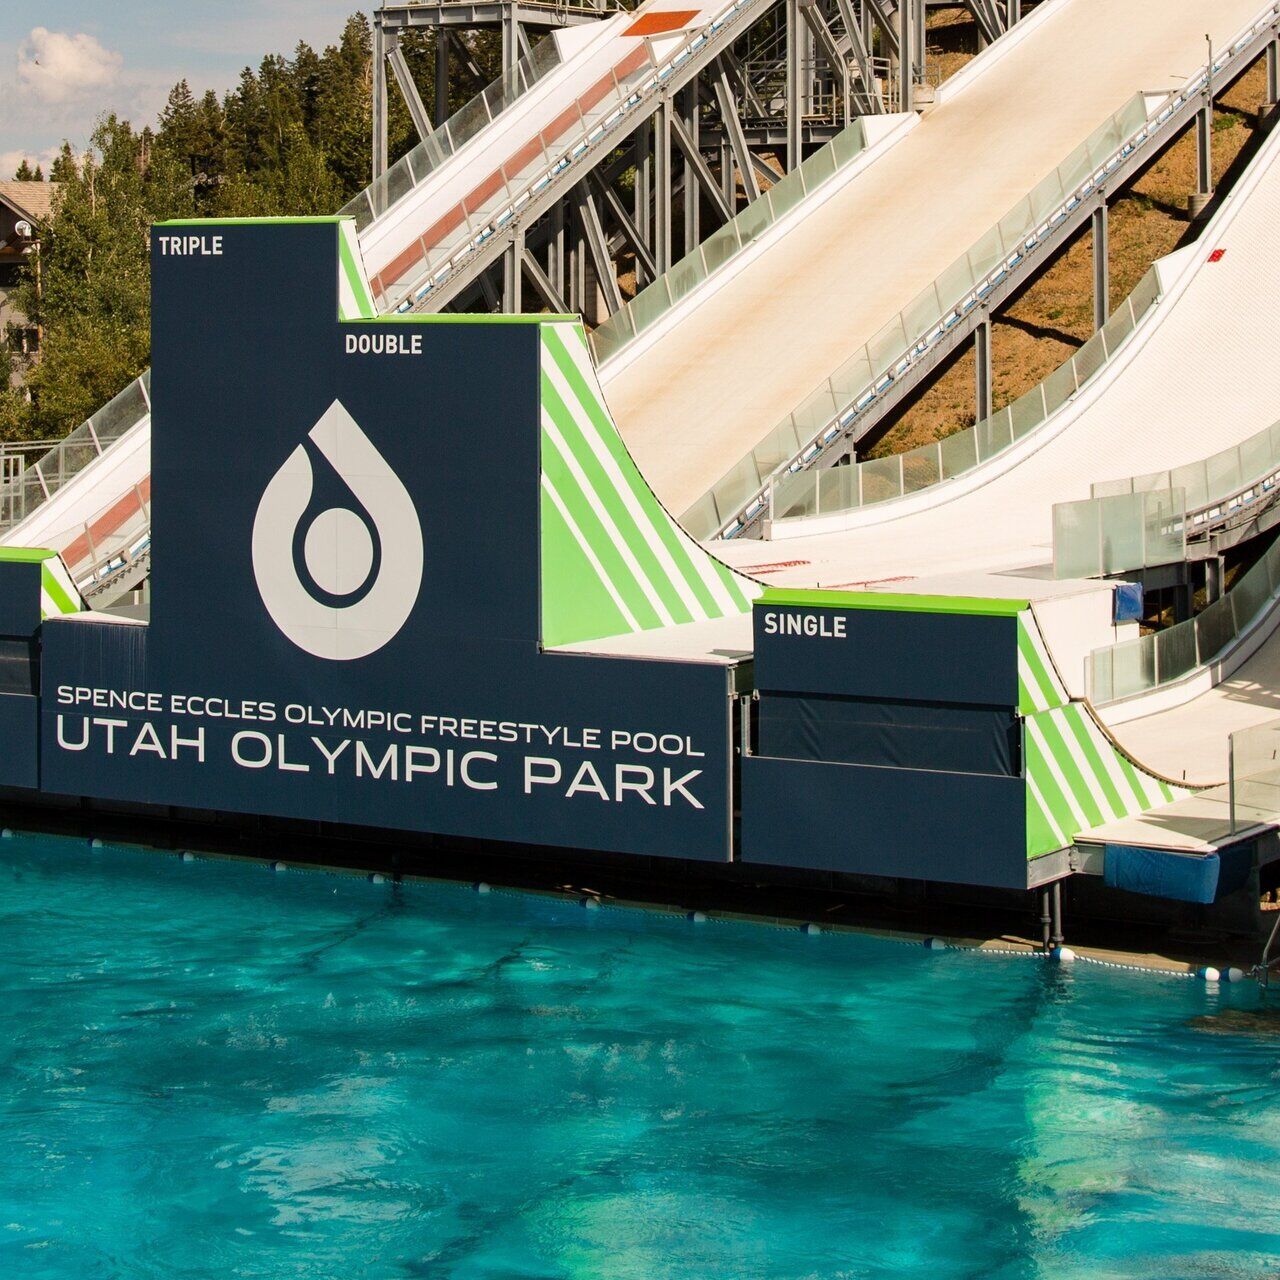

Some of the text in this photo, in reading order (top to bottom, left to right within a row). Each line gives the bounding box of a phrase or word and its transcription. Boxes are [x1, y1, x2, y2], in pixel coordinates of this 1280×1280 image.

[158, 235, 223, 256] TRIPLE
[345, 334, 423, 355] DOUBLE
[764, 612, 847, 638] SINGLE
[57, 685, 705, 756] SPENCE ECCLES OLYMPIC FREESTYLE POOL
[57, 714, 705, 809] UTAH OLYMPIC PARK
